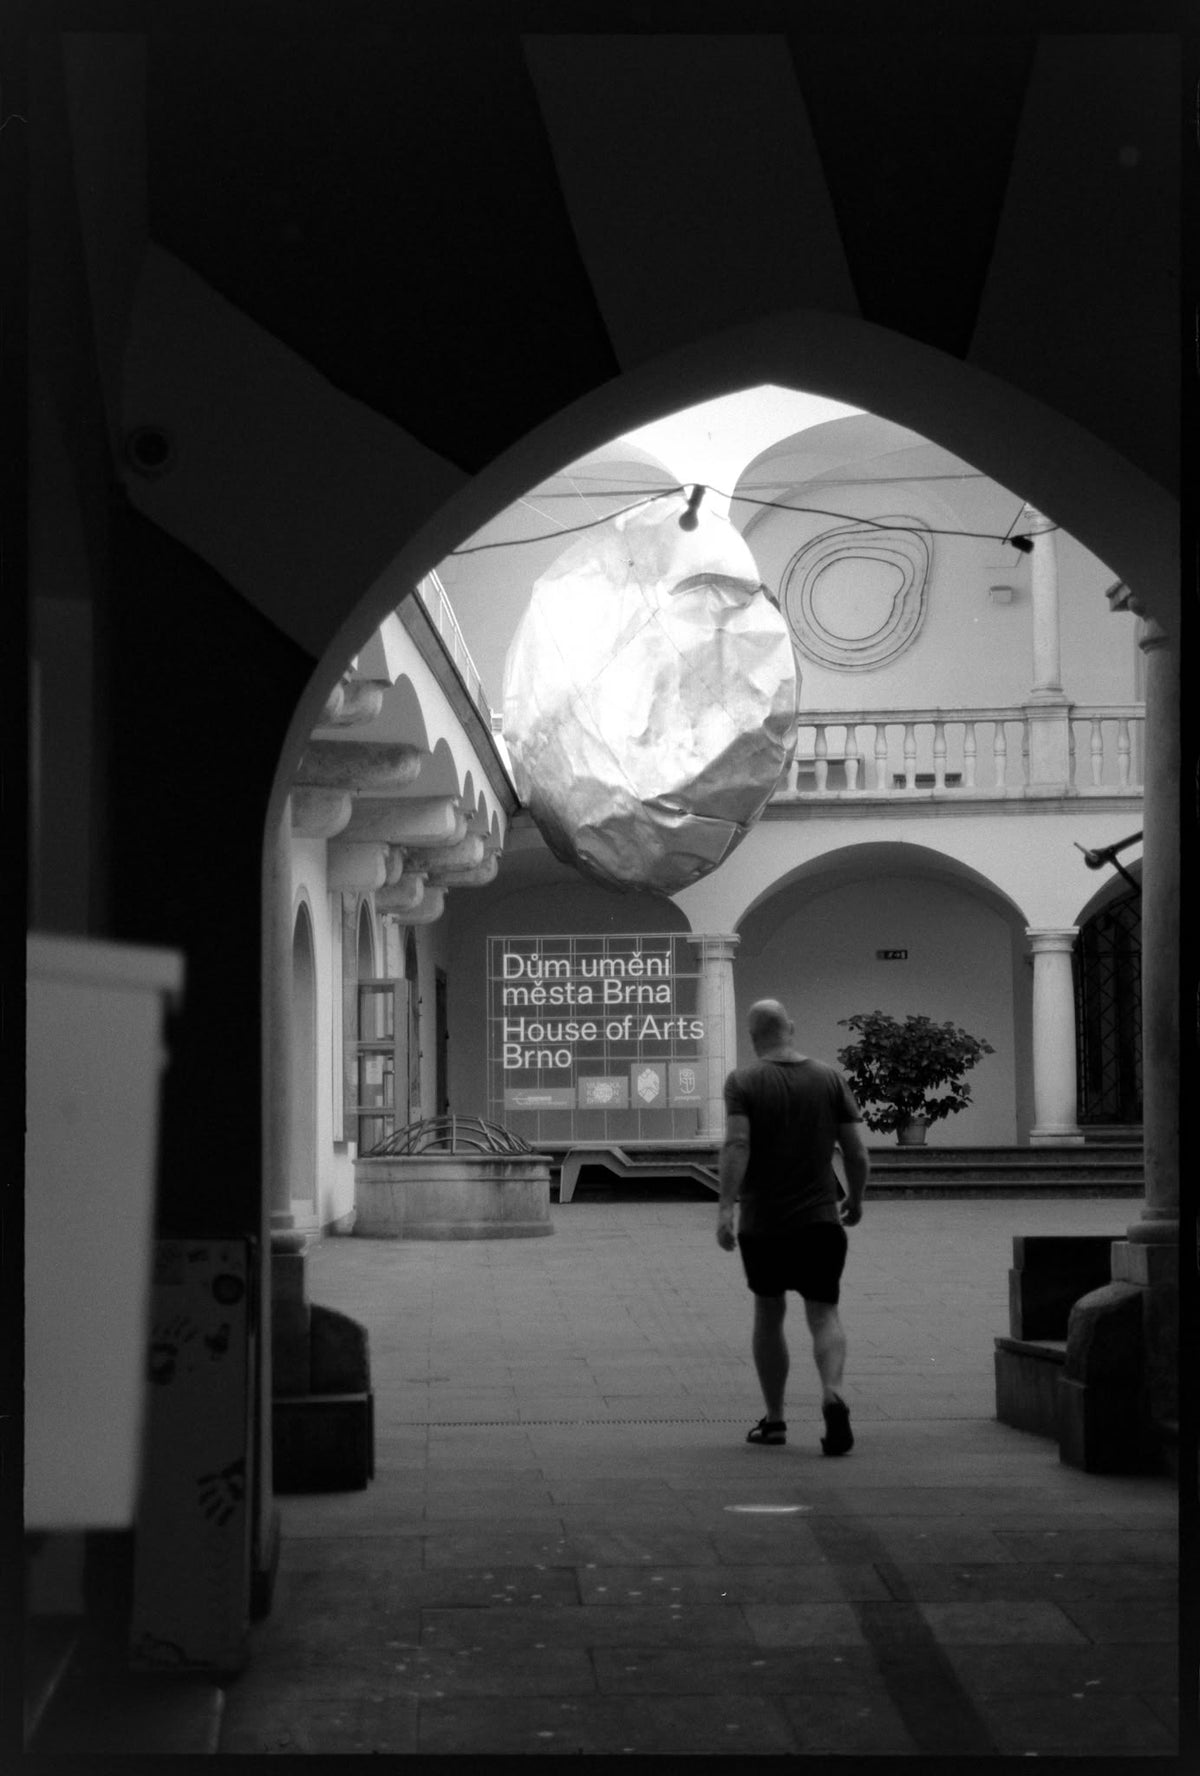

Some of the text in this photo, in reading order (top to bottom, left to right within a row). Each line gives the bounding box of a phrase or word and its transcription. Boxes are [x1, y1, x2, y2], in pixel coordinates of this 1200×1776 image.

[503, 951, 672, 979] Dům umění
[503, 979, 672, 1006] města Brna
[503, 1015, 705, 1042] House of Arts
[503, 1043, 572, 1069] Brno
